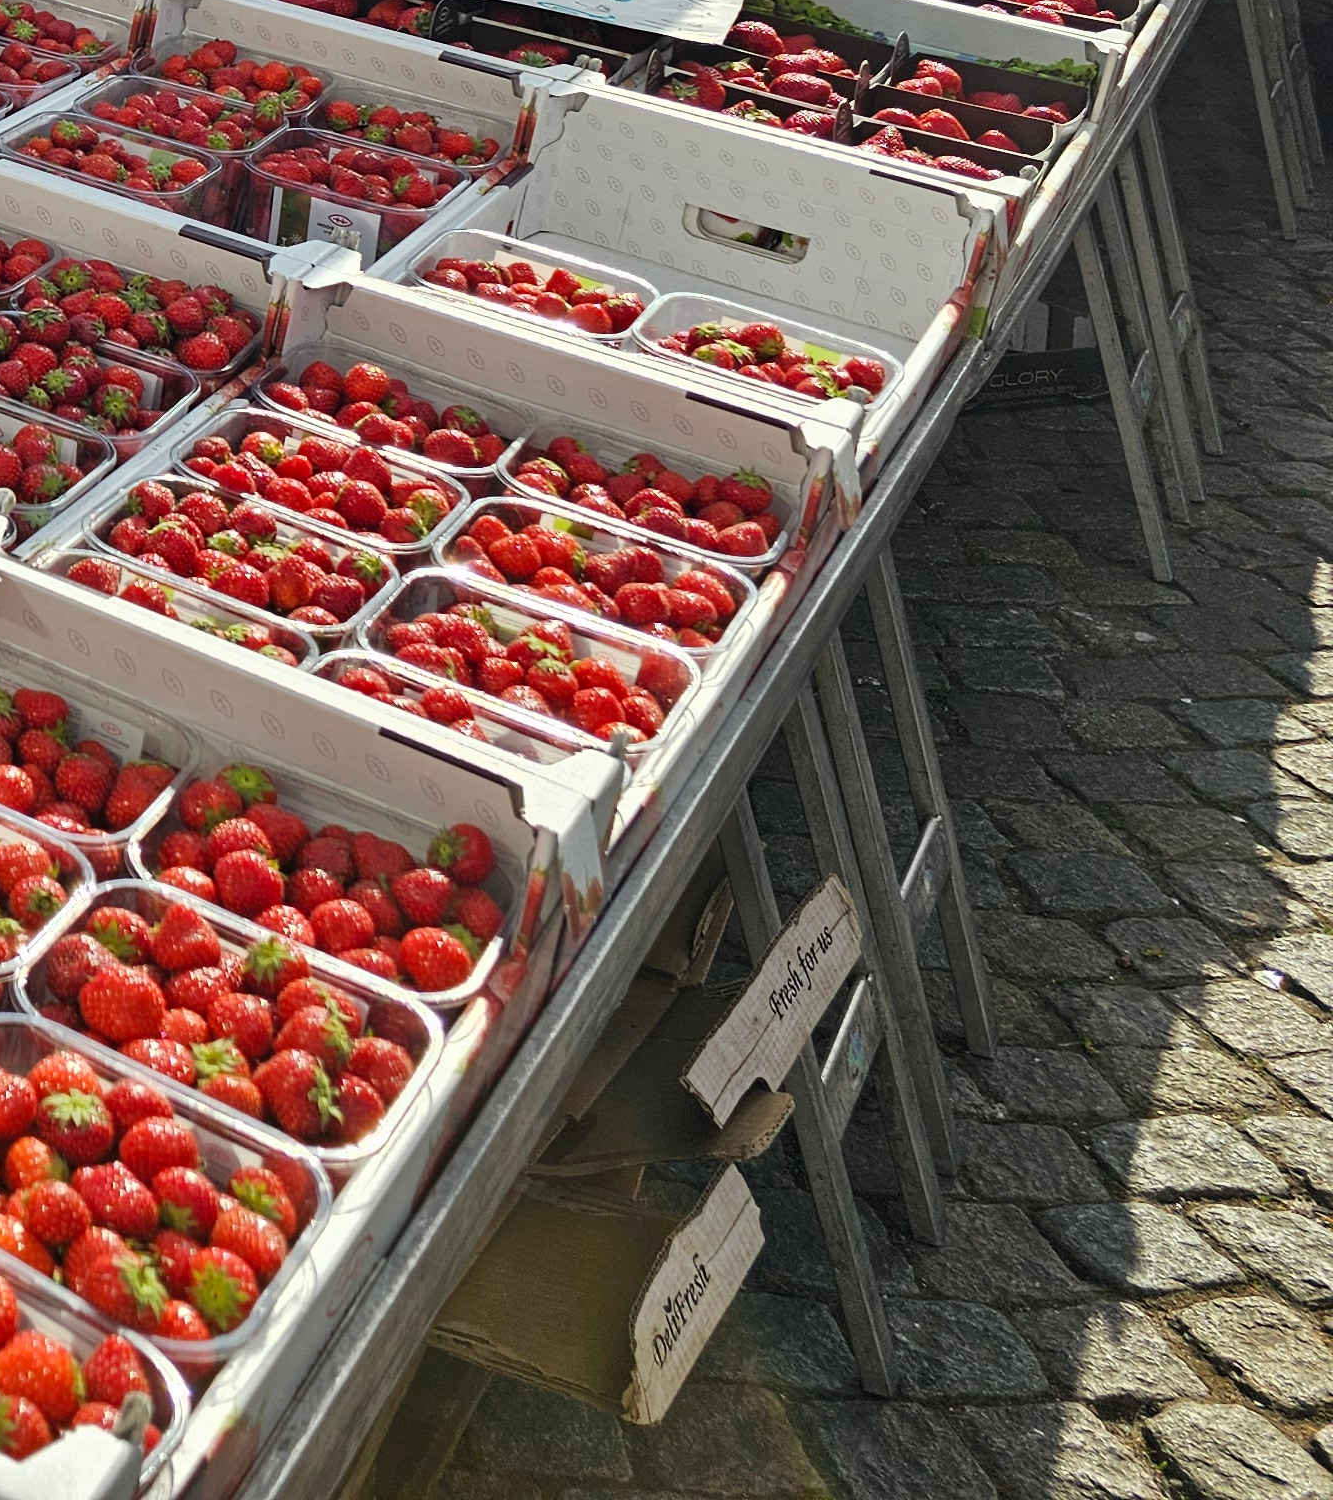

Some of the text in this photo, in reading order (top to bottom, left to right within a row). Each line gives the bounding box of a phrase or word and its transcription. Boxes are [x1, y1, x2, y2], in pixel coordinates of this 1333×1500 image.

[769, 926, 833, 1020] Fresh for us
[652, 1253, 712, 1369] DeliFresh
